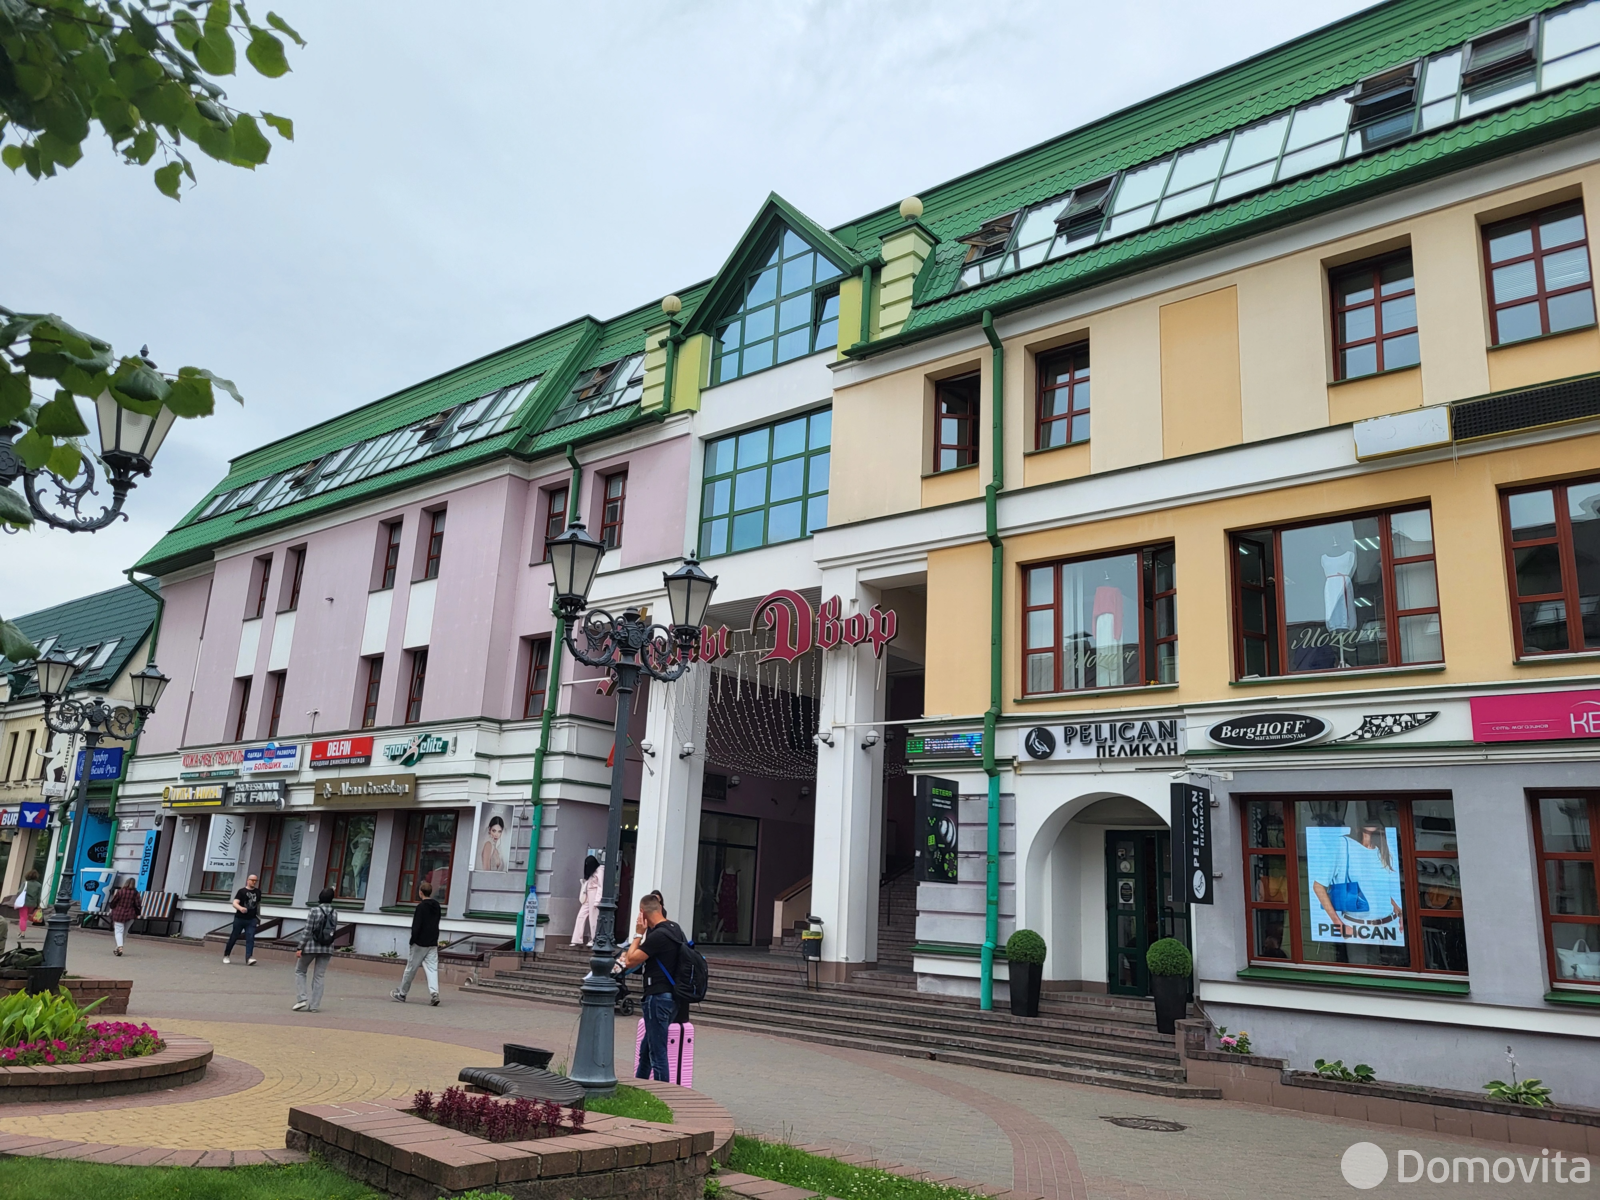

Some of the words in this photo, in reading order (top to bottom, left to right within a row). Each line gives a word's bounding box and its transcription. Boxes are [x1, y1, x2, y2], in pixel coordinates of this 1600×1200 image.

[750, 589, 899, 665] Двор
[1291, 626, 1380, 652] Mozart
[1064, 720, 1178, 746] PELICAN
[1220, 719, 1306, 740] BergHOFF
[1281, 732, 1306, 741] посуды
[276, 748, 296, 756] РАЗМЕРОВ
[327, 740, 352, 757] DELFIN
[383, 739, 411, 760] sport
[419, 737, 443, 754] elite
[1096, 742, 1178, 758] ПЕЛИКАН
[104, 763, 117, 778] Руси
[253, 762, 282, 771] БОЛЬШИХ
[235, 782, 280, 792] PROFESSIONAL
[233, 793, 246, 803] BY
[249, 791, 279, 803] FAMA
[218, 818, 236, 857] Mozart
[1191, 790, 1200, 867] PELICAN
[141, 845, 152, 876] ЗДЕСЬ
[1318, 923, 1397, 941] PELICAN
